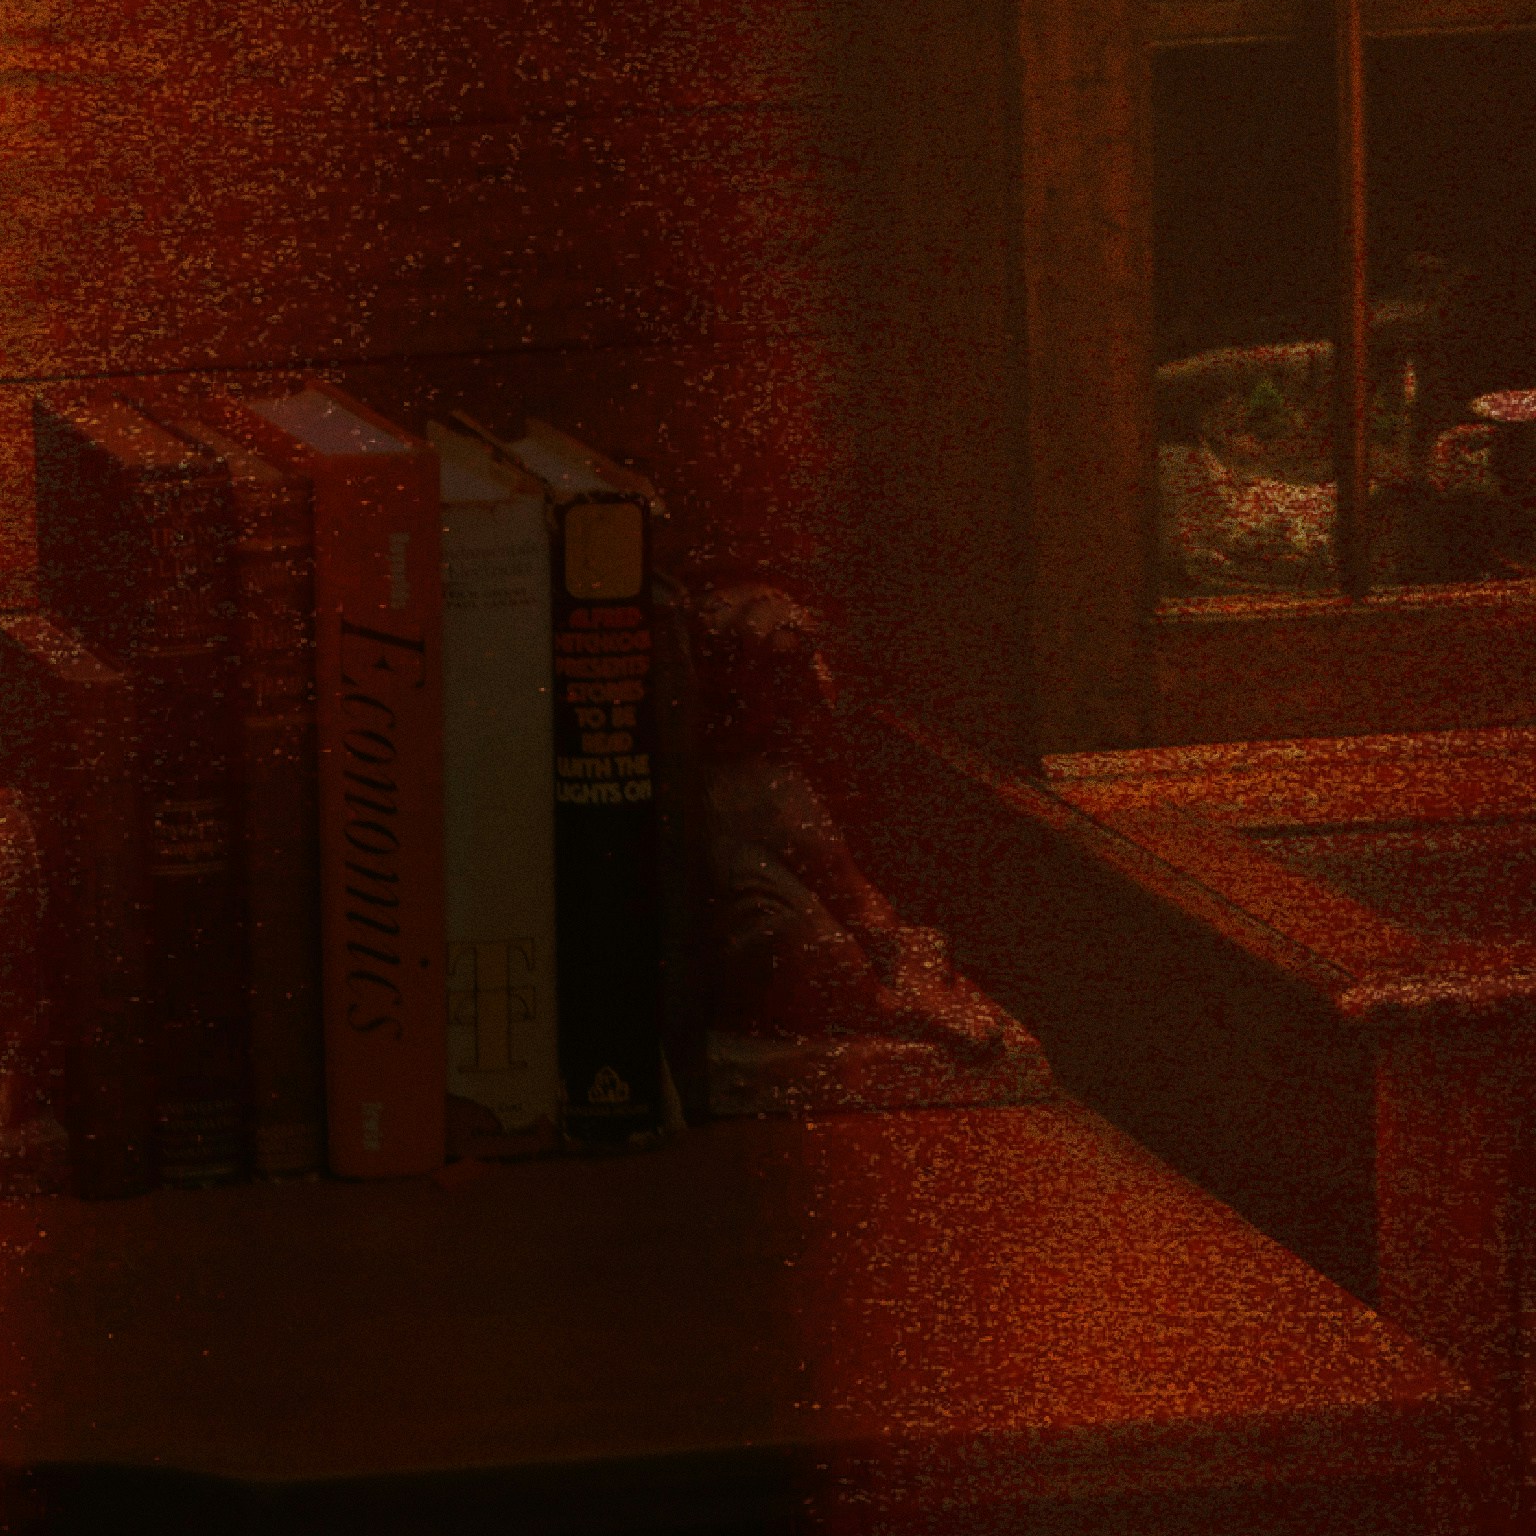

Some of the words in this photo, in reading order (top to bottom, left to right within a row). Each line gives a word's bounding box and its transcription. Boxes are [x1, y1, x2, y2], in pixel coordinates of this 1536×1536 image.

[568, 607, 642, 629] ALFRED
[566, 680, 645, 704] STORIES
[574, 706, 606, 730] TO
[611, 704, 637, 728] BE
[557, 755, 612, 779] WITH
[614, 753, 651, 778] THE
[556, 780, 623, 804] LIGHTS
[624, 778, 652, 802] ON
[341, 614, 429, 1042] Economics
